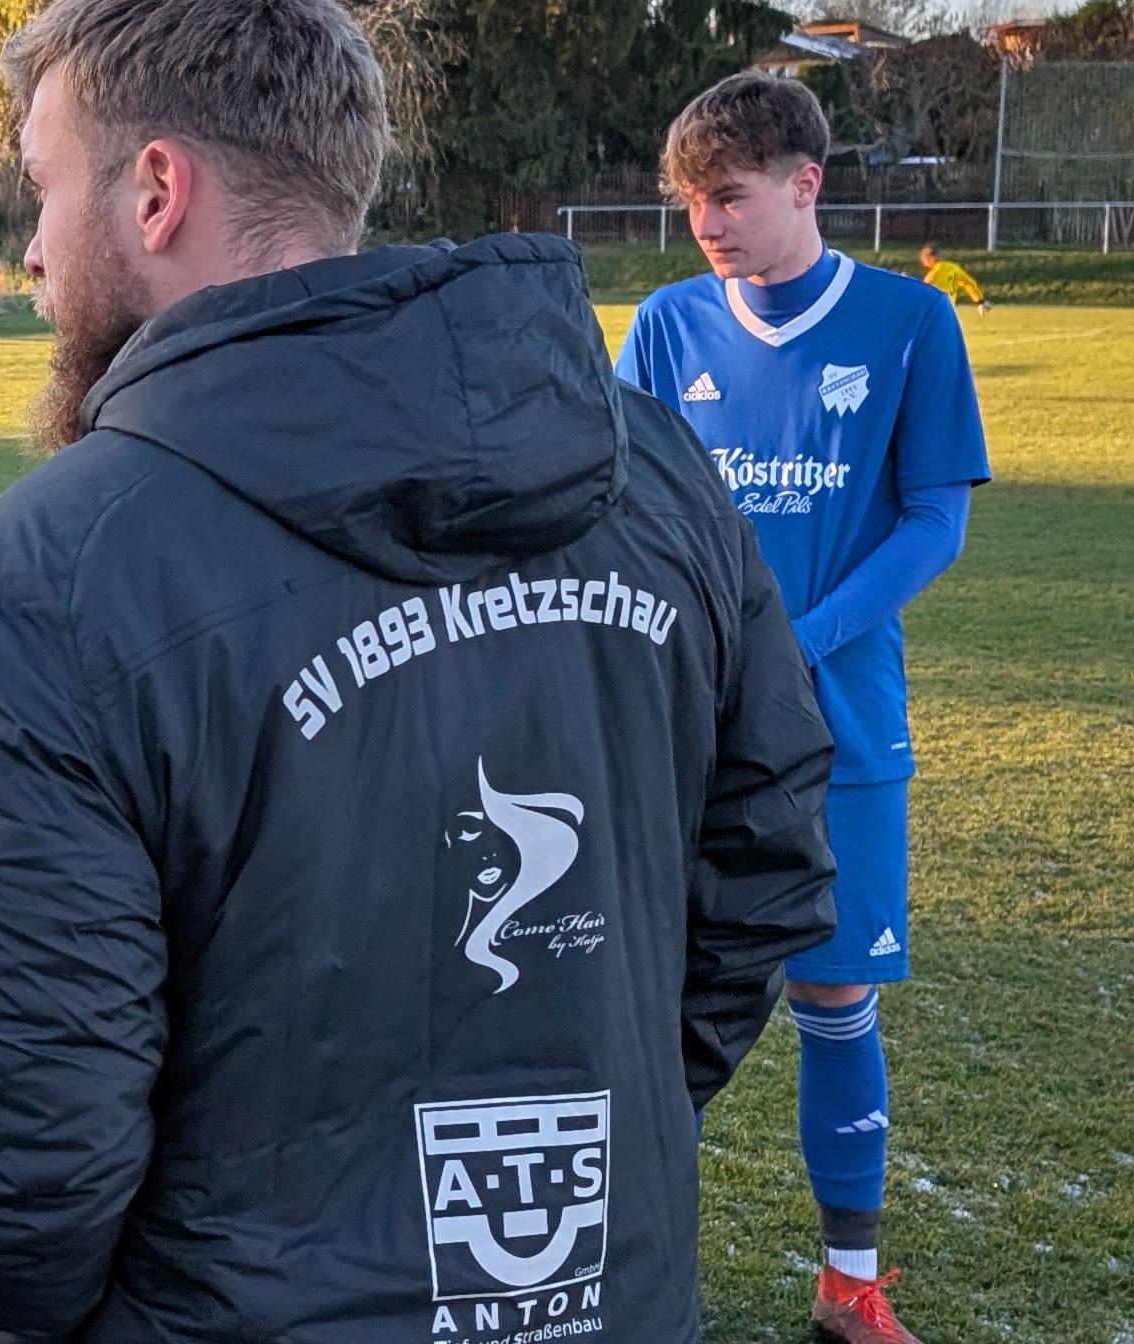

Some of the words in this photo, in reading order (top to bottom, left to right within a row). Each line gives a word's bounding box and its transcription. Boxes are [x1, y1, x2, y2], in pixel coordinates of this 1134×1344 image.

[683, 389, 722, 402] adidas
[710, 447, 851, 496] Köstritzer
[737, 492, 782, 516] Edel
[775, 490, 813, 516] Pils
[282, 654, 344, 741] SV
[336, 596, 437, 689] 1893
[438, 570, 678, 646] Kretzschau
[547, 933, 566, 959] by
[574, 1261, 601, 1278] GmbH
[431, 1281, 602, 1335] ANTON
